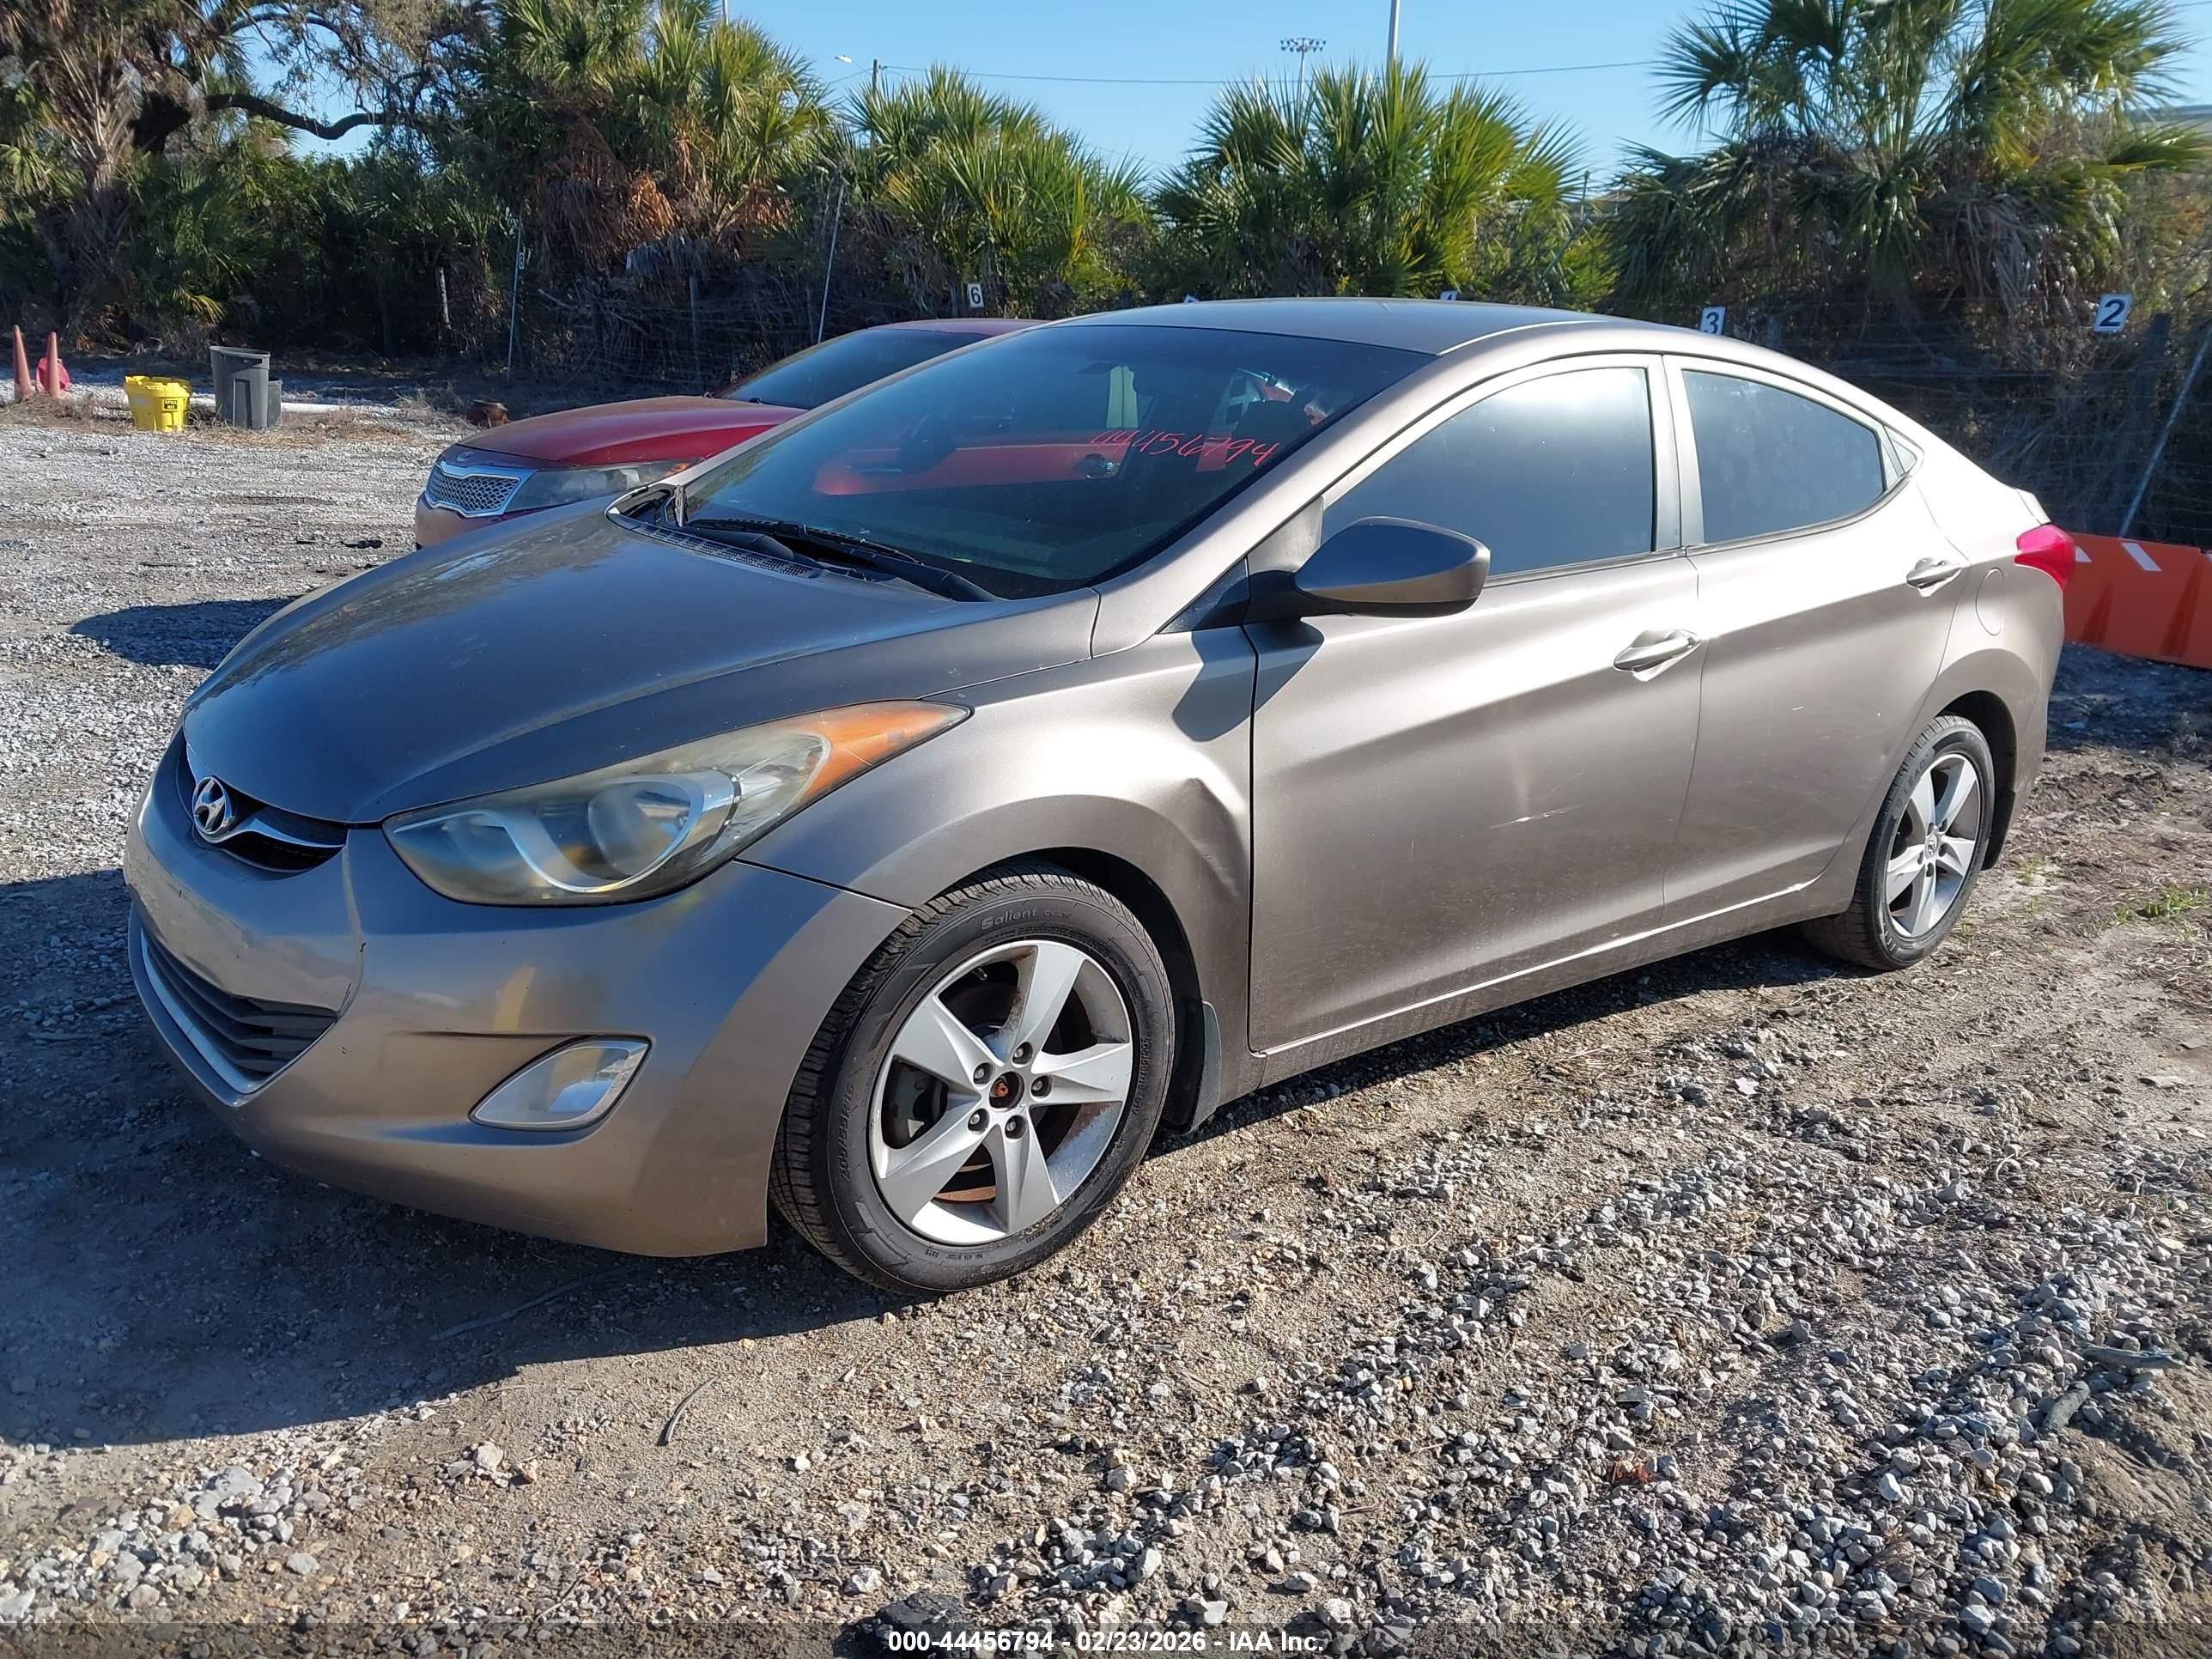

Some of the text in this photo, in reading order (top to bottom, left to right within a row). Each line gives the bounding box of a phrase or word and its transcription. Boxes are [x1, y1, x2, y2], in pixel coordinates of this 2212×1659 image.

[970, 286, 981, 304] 6
[1705, 311, 1720, 334] 3
[2099, 298, 2125, 326] 2
[981, 907, 1036, 930] Salient
